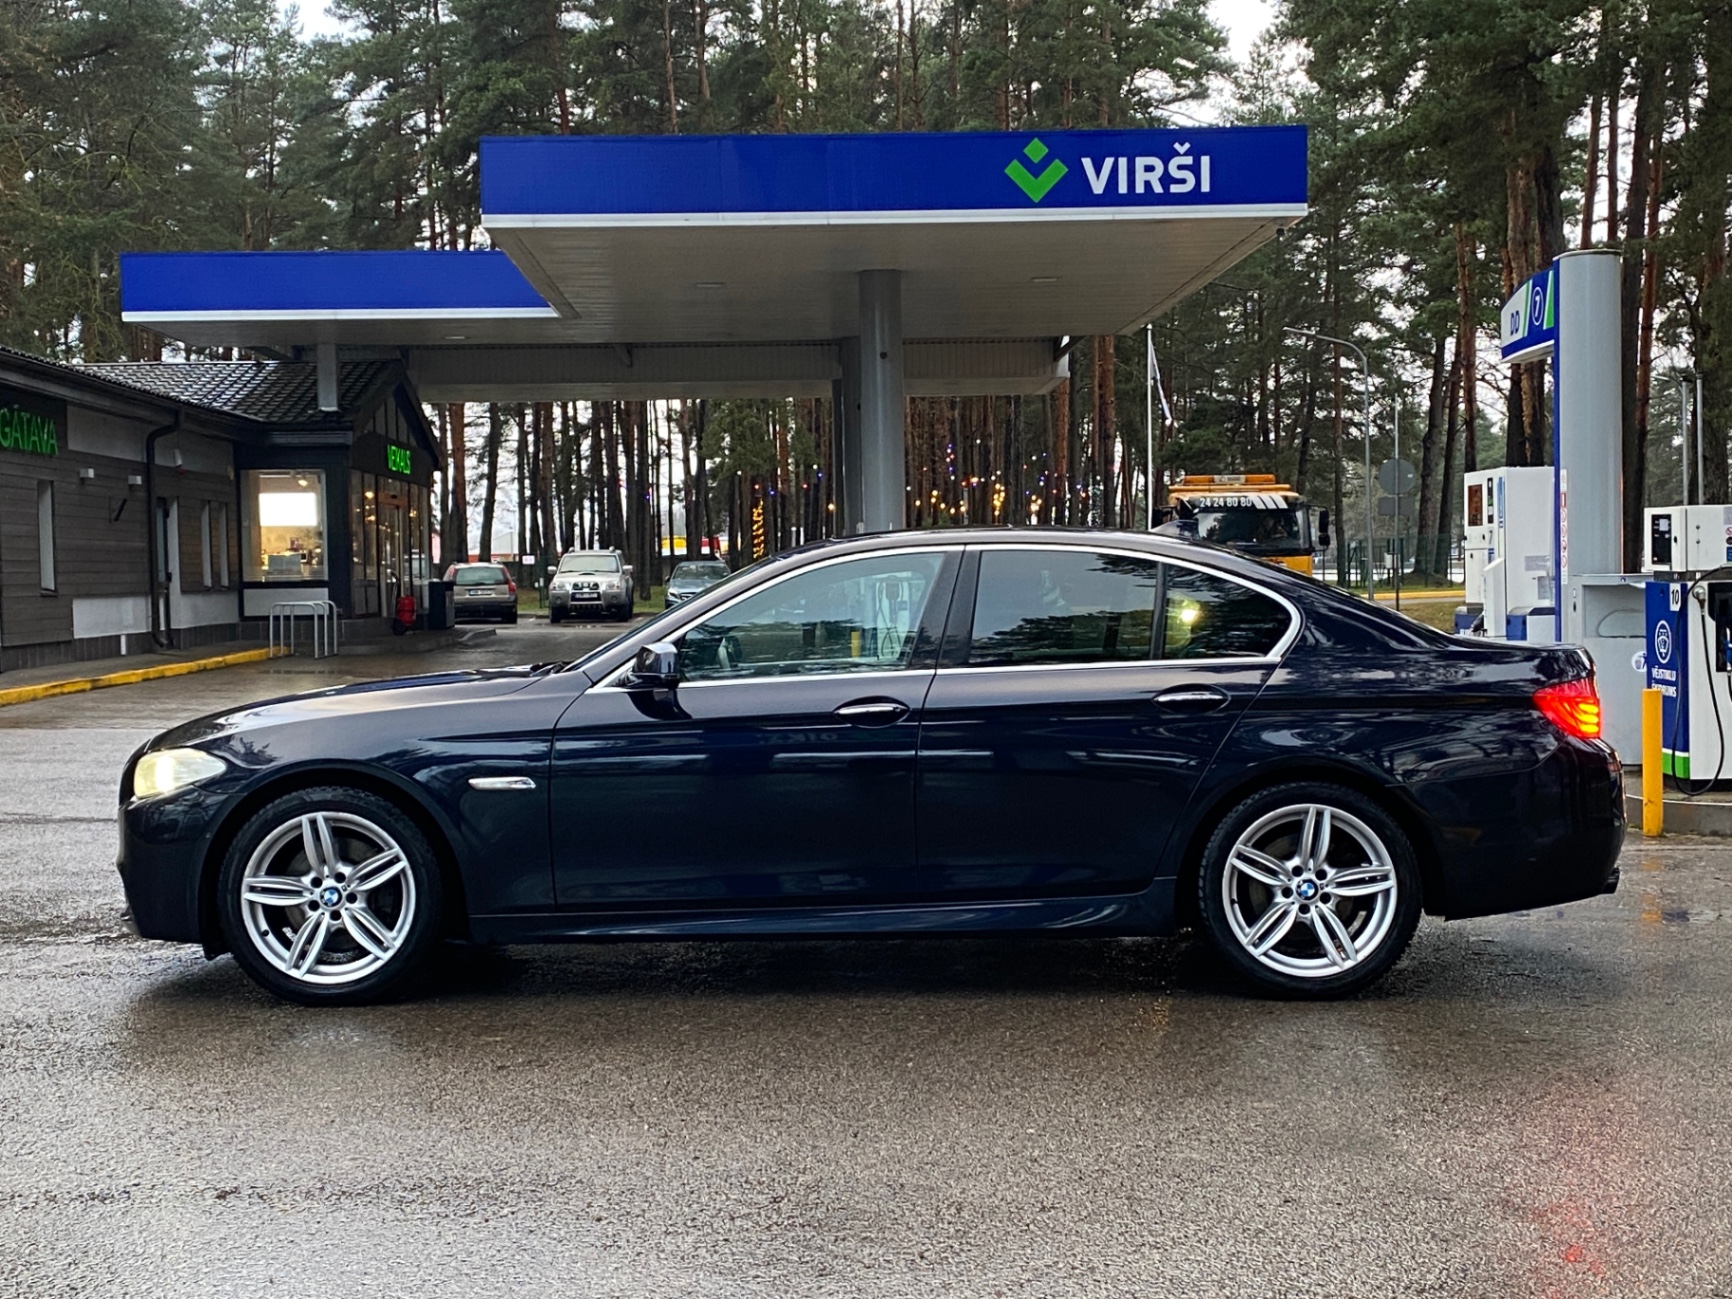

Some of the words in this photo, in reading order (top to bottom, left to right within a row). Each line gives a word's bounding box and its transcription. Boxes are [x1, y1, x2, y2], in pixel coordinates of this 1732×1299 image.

[1081, 141, 1210, 195] VIRŠI
[1534, 294, 1541, 318] 7
[1510, 310, 1520, 336] DD
[0, 404, 59, 457] GĀTAVA
[387, 444, 411, 475] VEIKALS
[1200, 497, 1211, 507] 24
[1213, 497, 1224, 507] 24
[1226, 497, 1238, 507] 80
[1240, 497, 1252, 507] 80
[1671, 589, 1680, 605] 10
